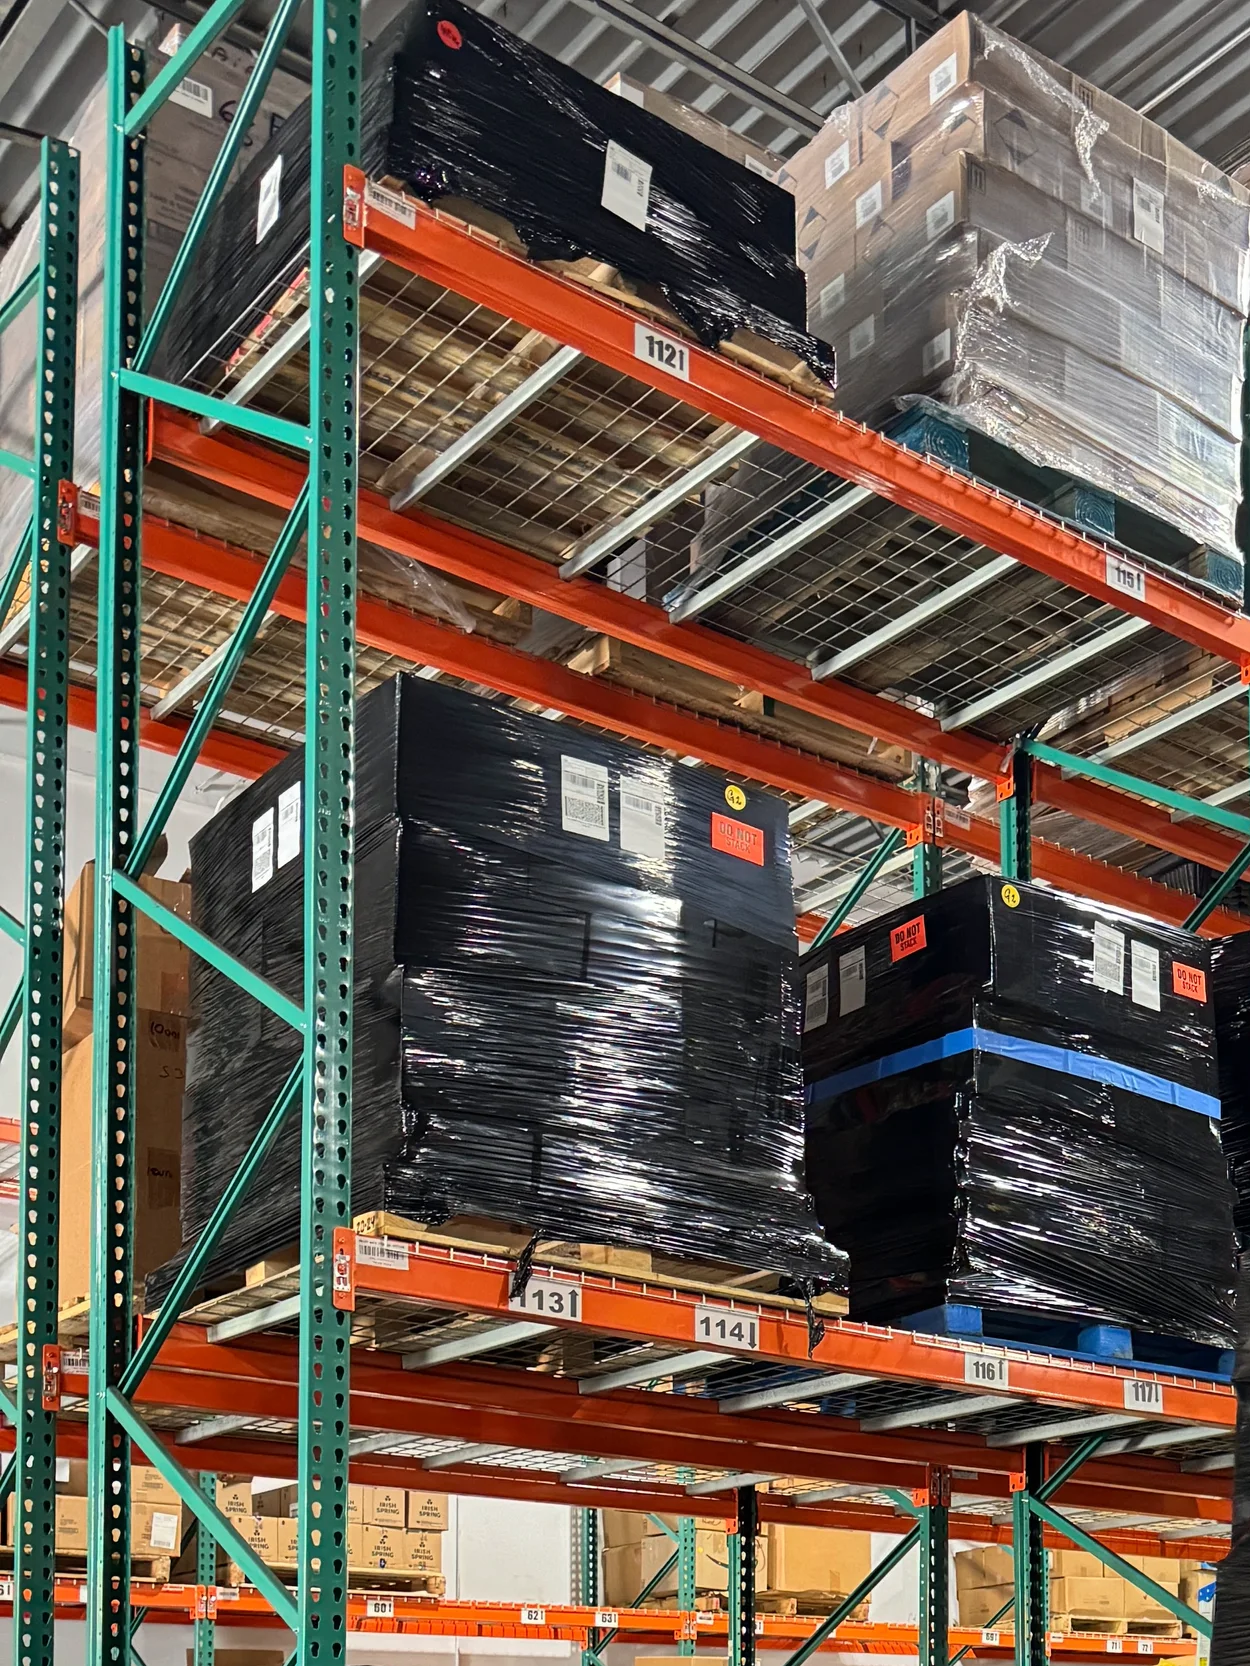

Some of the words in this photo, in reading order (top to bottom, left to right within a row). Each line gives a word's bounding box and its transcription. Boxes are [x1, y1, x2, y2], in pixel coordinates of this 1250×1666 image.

[720, 821, 733, 837] DO
[736, 827, 757, 846] NOT
[726, 836, 751, 854] STACK
[894, 930, 905, 945] DO
[906, 921, 921, 939] NOT
[900, 936, 918, 951] STACK
[1177, 968, 1187, 981] DO
[1188, 972, 1202, 986] NOT
[1182, 980, 1199, 993] STACK
[700, 1316, 745, 1342] 114
[973, 1361, 995, 1380] 116
